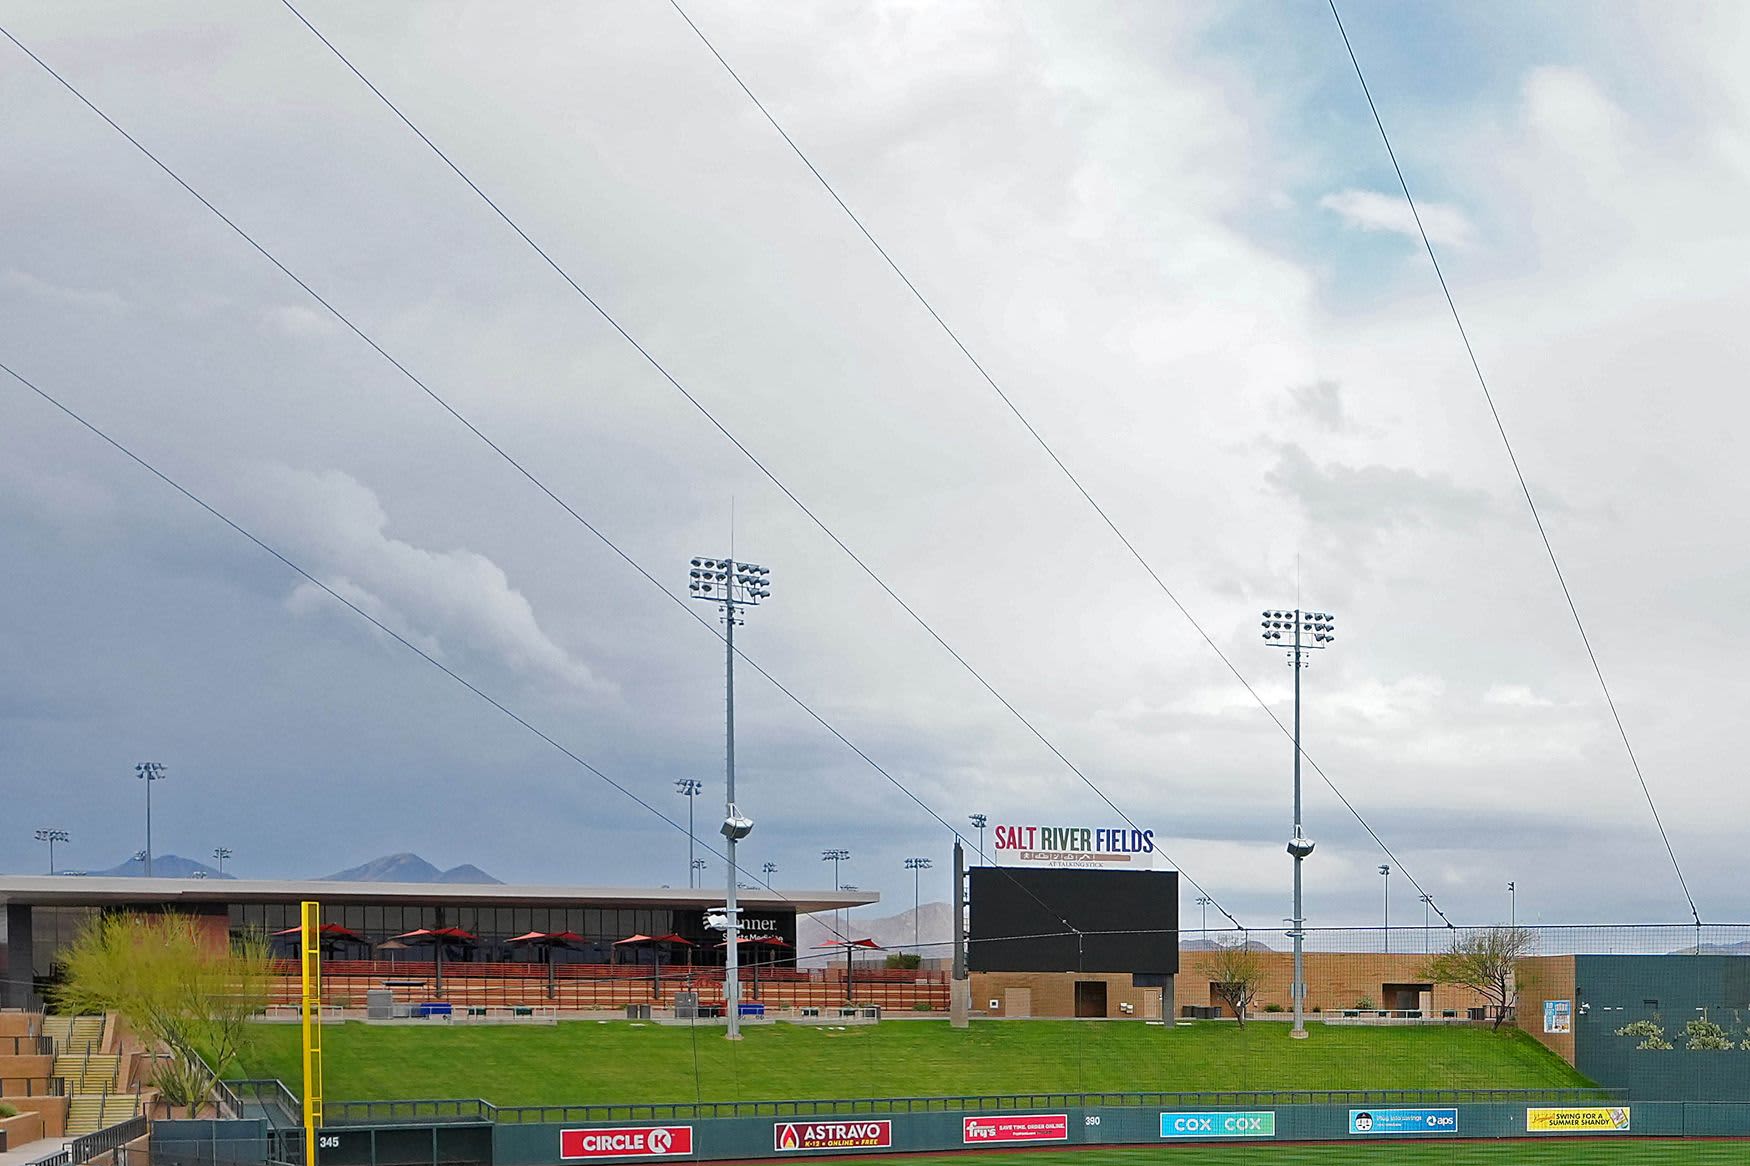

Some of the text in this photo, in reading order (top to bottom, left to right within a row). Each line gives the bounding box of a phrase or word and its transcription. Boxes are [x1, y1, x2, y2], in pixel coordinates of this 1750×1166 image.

[995, 825, 1154, 854] SALT RIVER FIELDS
[1085, 1116, 1100, 1126] 390
[1174, 1117, 1262, 1132] COX COX
[1437, 1117, 1454, 1126] aps
[804, 1124, 880, 1140] ASTRAVO
[966, 1120, 997, 1138] fry's
[319, 1136, 339, 1148] 345
[583, 1133, 645, 1151] CIRCLE
[827, 1139, 854, 1147] ONLINE
[860, 1138, 878, 1146] FREE
